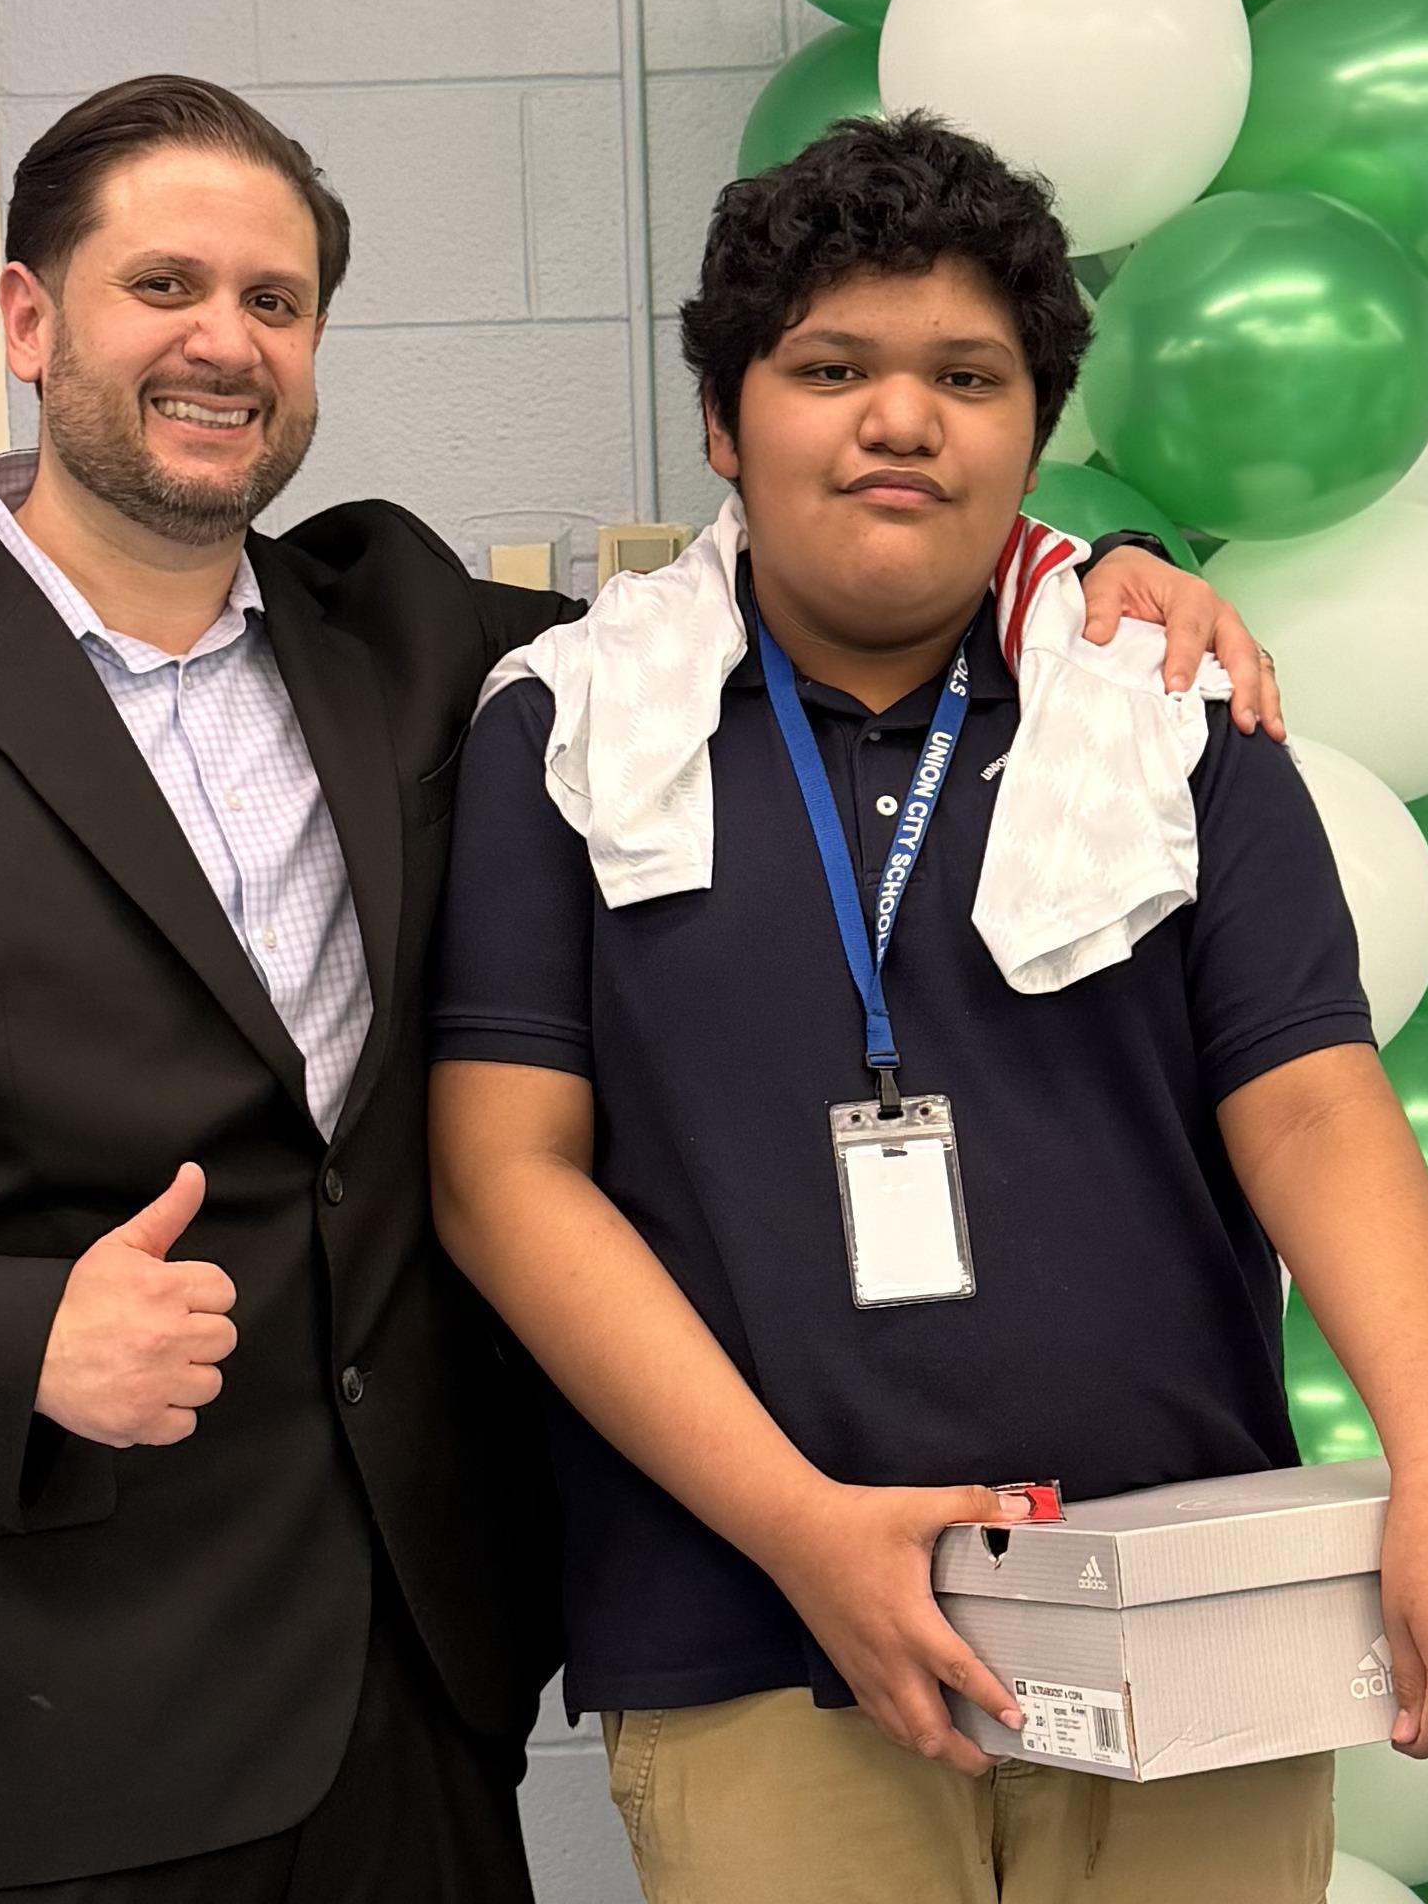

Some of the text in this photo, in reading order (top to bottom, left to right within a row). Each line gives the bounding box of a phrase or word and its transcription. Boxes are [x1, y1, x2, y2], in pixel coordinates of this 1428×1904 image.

[913, 731, 953, 798] UNION
[898, 801, 929, 851] CITY
[1350, 1666, 1394, 1700] adi
